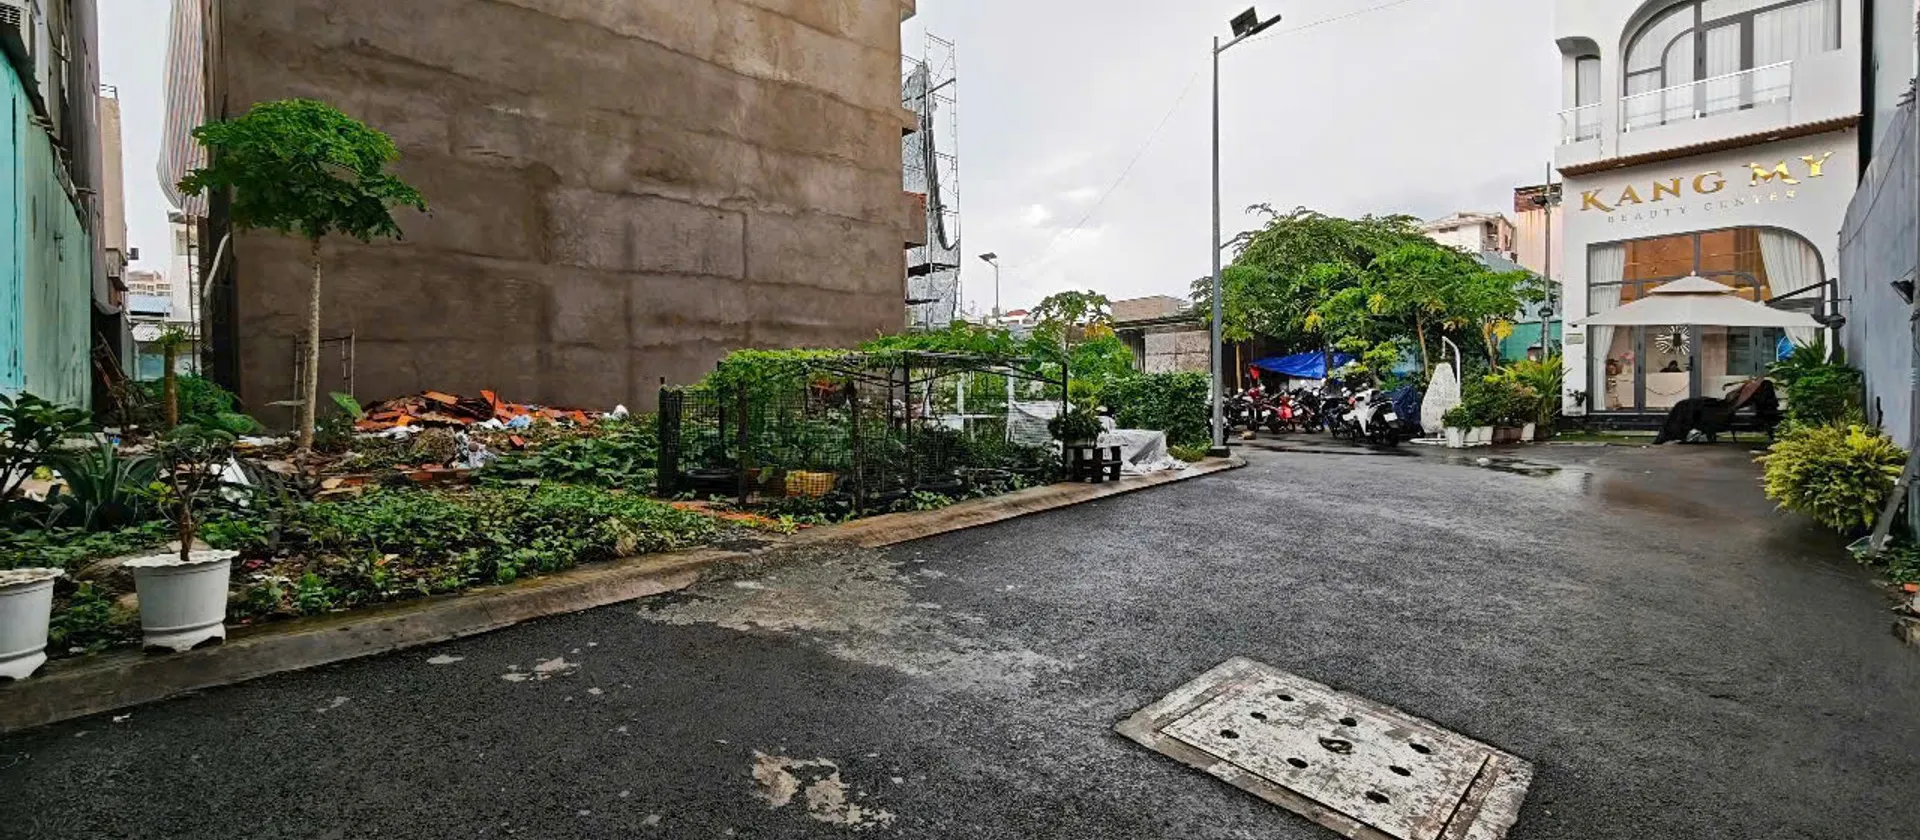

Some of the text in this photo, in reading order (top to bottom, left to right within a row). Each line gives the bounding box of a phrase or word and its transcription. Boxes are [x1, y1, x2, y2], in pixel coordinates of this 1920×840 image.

[1580, 151, 1836, 212] KANG MY
[1607, 191, 1796, 223] BEAUTY CENTER
